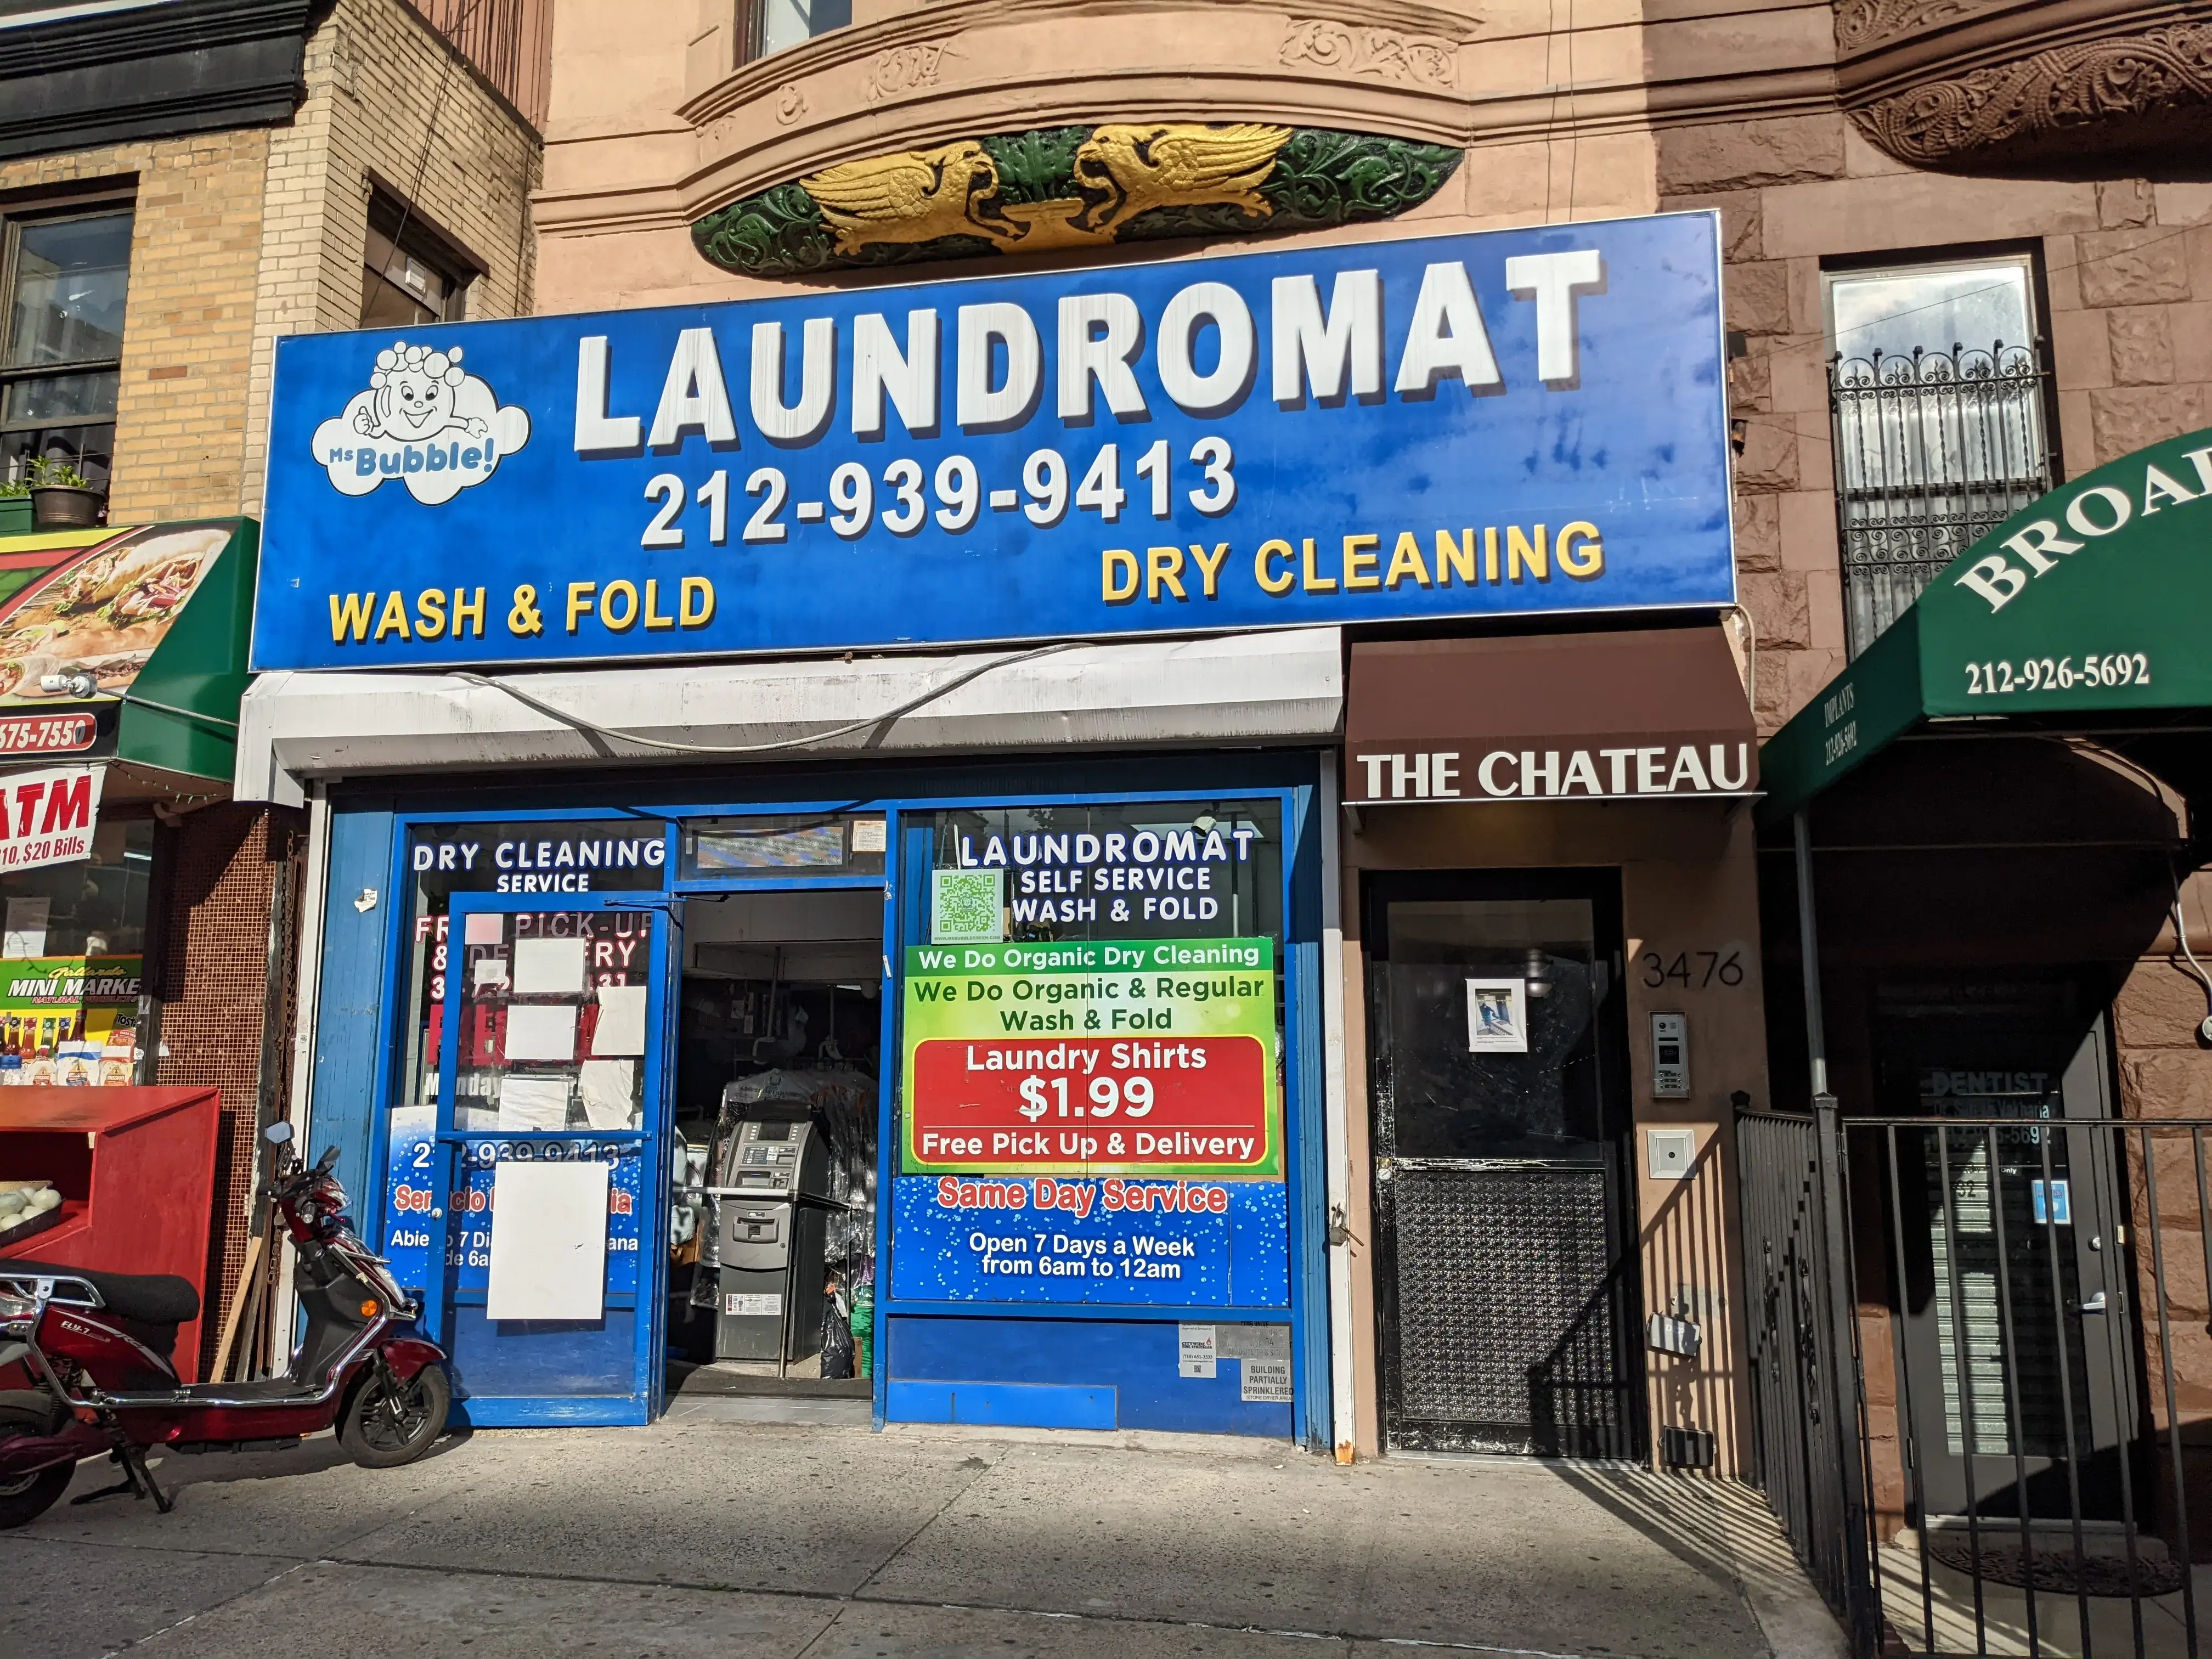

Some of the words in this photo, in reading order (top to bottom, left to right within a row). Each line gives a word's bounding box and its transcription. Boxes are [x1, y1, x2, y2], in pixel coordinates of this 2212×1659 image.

[574, 250, 1602, 453] LAUNDROMAT
[330, 449, 353, 464] Ms
[356, 437, 495, 477] Bubble!
[641, 436, 1237, 546] 212-939-9413
[1102, 543, 1229, 602] DRY
[1255, 521, 1603, 594] CLEANING
[329, 586, 486, 642] WASH
[507, 584, 543, 635] &
[566, 577, 715, 632] FOLD
[1965, 653, 2151, 695] 212-926-5692
[1357, 753, 1460, 799] THE
[1478, 743, 1748, 797] CHATEAU
[0, 845, 20, 866] 10,
[22, 839, 51, 864] $20
[53, 836, 84, 858] Bills
[414, 843, 479, 871] DRY
[495, 840, 665, 868] CLEANING
[962, 830, 1255, 866] LAUNDROMAT
[496, 873, 589, 893] SERVICE
[1021, 870, 1082, 894] SELF
[1094, 867, 1211, 891] SERVICE
[1013, 899, 1096, 923] WASH
[1110, 899, 1130, 922] &
[1144, 897, 1218, 921] FOLD
[918, 950, 956, 969] We
[964, 950, 996, 968] Do
[1003, 947, 1096, 972] Organic
[1104, 949, 1146, 969] Dry
[1153, 944, 1260, 967] Cleaning
[1642, 951, 1744, 989] 3476
[7, 979, 59, 997] MINI
[31, 996, 81, 1005] NATURAL
[914, 981, 957, 1003] We
[967, 981, 1003, 1002] Do
[1013, 978, 1119, 1005] Organic
[1128, 978, 1147, 998] &
[1157, 977, 1265, 1002] Regular
[1000, 1009, 1074, 1031] Wash
[1084, 1010, 1102, 1030] &
[1111, 1007, 1172, 1030] Fold
[967, 1043, 1099, 1075] Laundry
[1111, 1042, 1207, 1069] Shirts
[425, 1073, 502, 1098] Mnday
[1932, 1071, 2048, 1096] DENTIST
[1019, 1074, 1154, 1123] $1.99
[923, 1134, 983, 1156] Free
[993, 1132, 1050, 1155] Pick
[1059, 1133, 1098, 1160] Up
[1106, 1134, 1126, 1155] &
[1136, 1132, 1255, 1160] Delivery
[396, 1184, 486, 1213] Sercio
[938, 1177, 1027, 1209] Same
[1034, 1177, 1096, 1219] Day
[1103, 1178, 1227, 1214] Service
[460, 1232, 469, 1248] 7
[970, 1232, 1027, 1257] Open
[1035, 1234, 1046, 1253] 7
[1053, 1234, 1107, 1259] Days
[1114, 1240, 1126, 1255] a
[1132, 1236, 1195, 1257] Week
[983, 1255, 1032, 1275] from
[1039, 1257, 1086, 1277] 6am
[1092, 1259, 1113, 1277] to
[1120, 1259, 1181, 1279] 12am
[61, 1320, 90, 1334] FLY-7
[1249, 1375, 1288, 1385] PARTIALLY
[1250, 1365, 1285, 1374] BUILDING
[1243, 1386, 1294, 1396] SPRINKLERED
